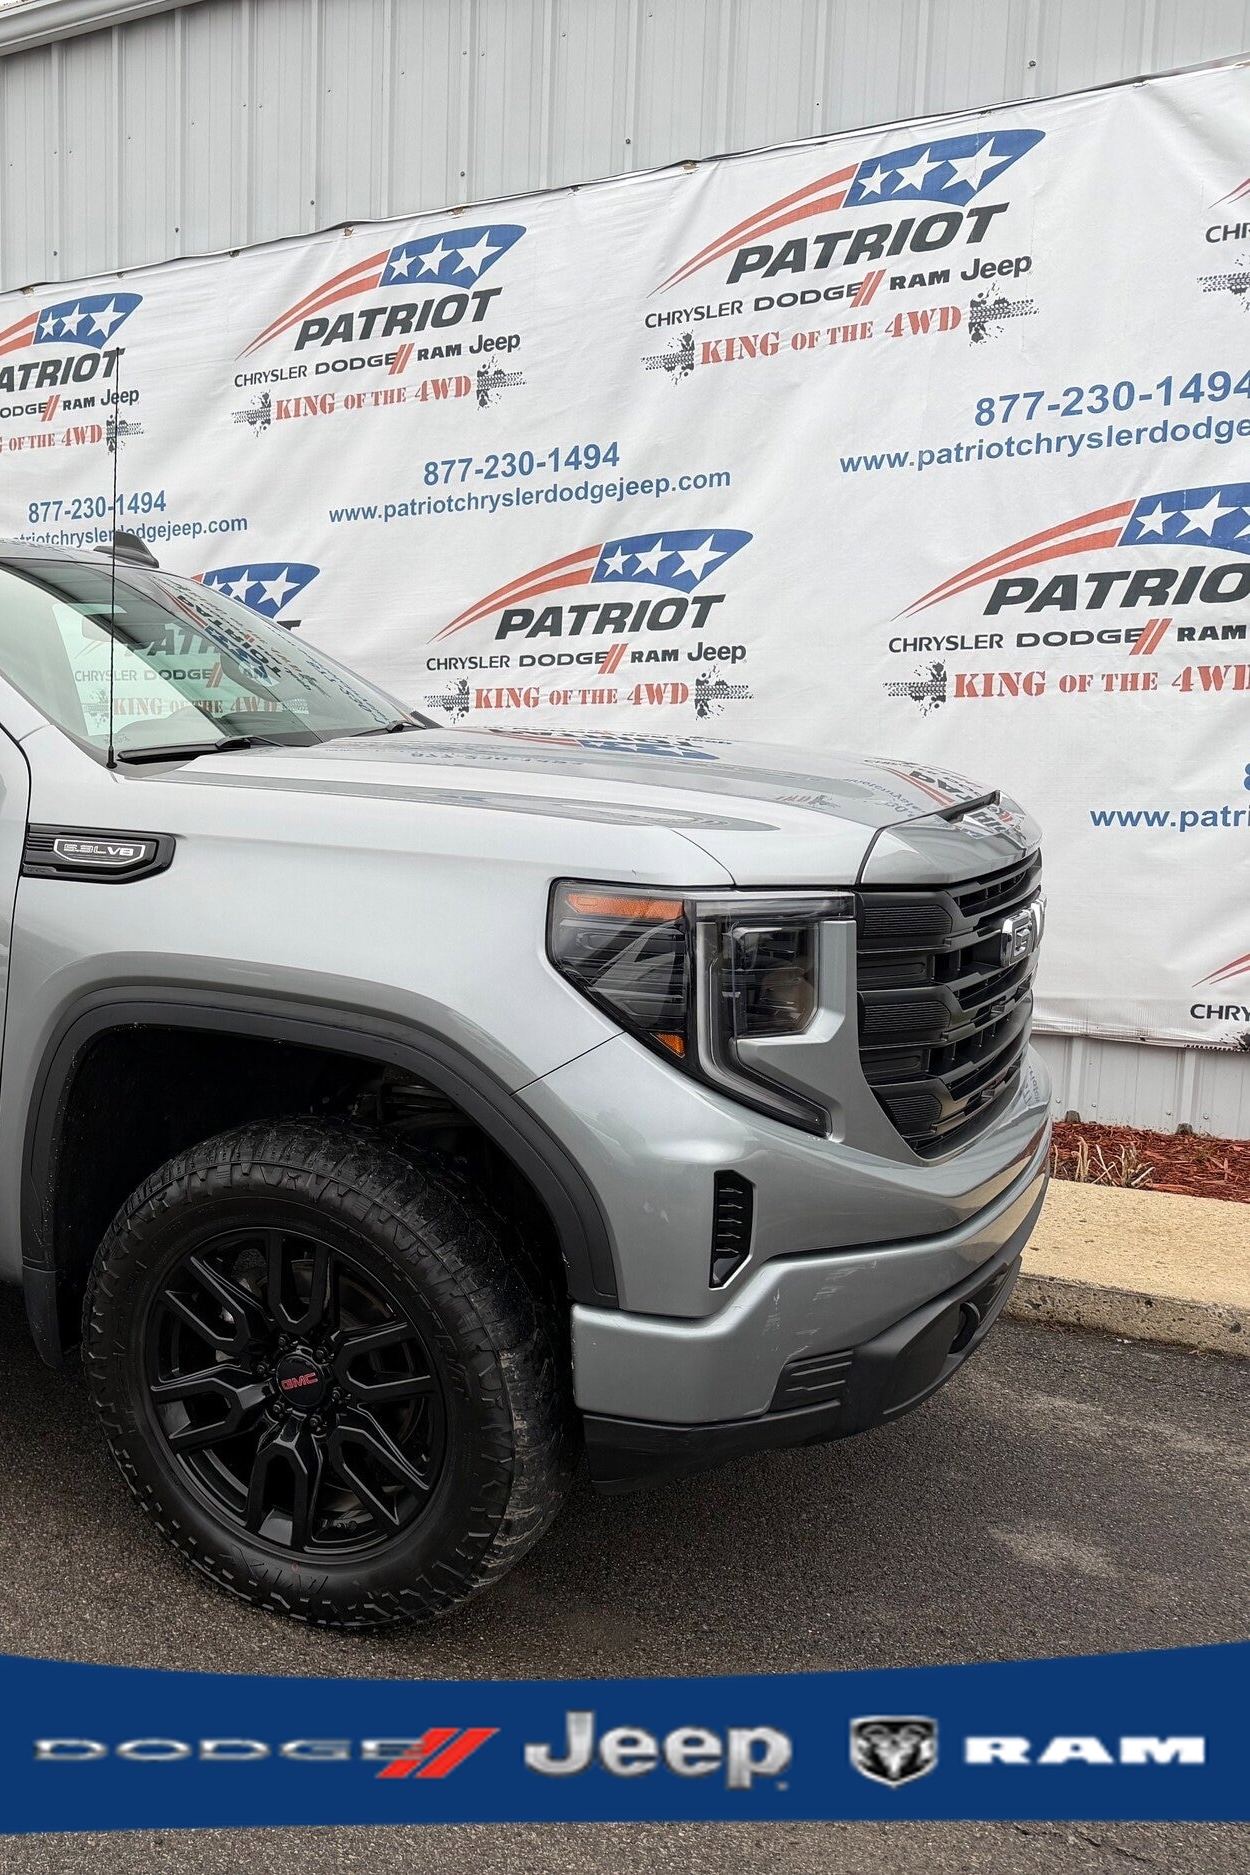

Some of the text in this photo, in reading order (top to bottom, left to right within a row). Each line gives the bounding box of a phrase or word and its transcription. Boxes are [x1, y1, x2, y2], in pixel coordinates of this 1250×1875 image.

[726, 202, 1010, 285] PATRIOT
[644, 254, 1033, 329] CHRYSLER DODGE RAM Jeep
[293, 287, 503, 351] PATRIOT
[700, 304, 962, 366] KING OF THE 4WD
[234, 333, 521, 389] CHRYSLER DODGE RAM Jeep
[62, 395, 96, 412] RAM
[100, 388, 139, 409] Jeep
[274, 375, 472, 421] KING OF THE 4WD
[974, 370, 1250, 428] 877-230-1494
[8, 436, 24, 452] OF
[28, 431, 56, 449] THE
[61, 423, 103, 448] 4WD
[839, 416, 1250, 474] www.patriotchryslerdodge
[423, 441, 620, 487] 877-230-1494
[28, 489, 167, 524] 877-230-1494
[328, 469, 732, 524] www.patriotchryslerdodgejeep.com
[495, 595, 725, 641] PATRIOT
[888, 624, 1246, 654] CHRYSLER DODGE RAM
[144, 669, 213, 681] DODGE
[426, 641, 747, 672] CHRYSLER DODGE RAM Jeep
[114, 697, 162, 716] KING
[473, 681, 689, 710] KING OF THE 4WD
[953, 669, 1047, 699] KING
[1059, 672, 1092, 693] OF
[1101, 671, 1158, 692] THE
[280, 1372, 319, 1390] GMC
